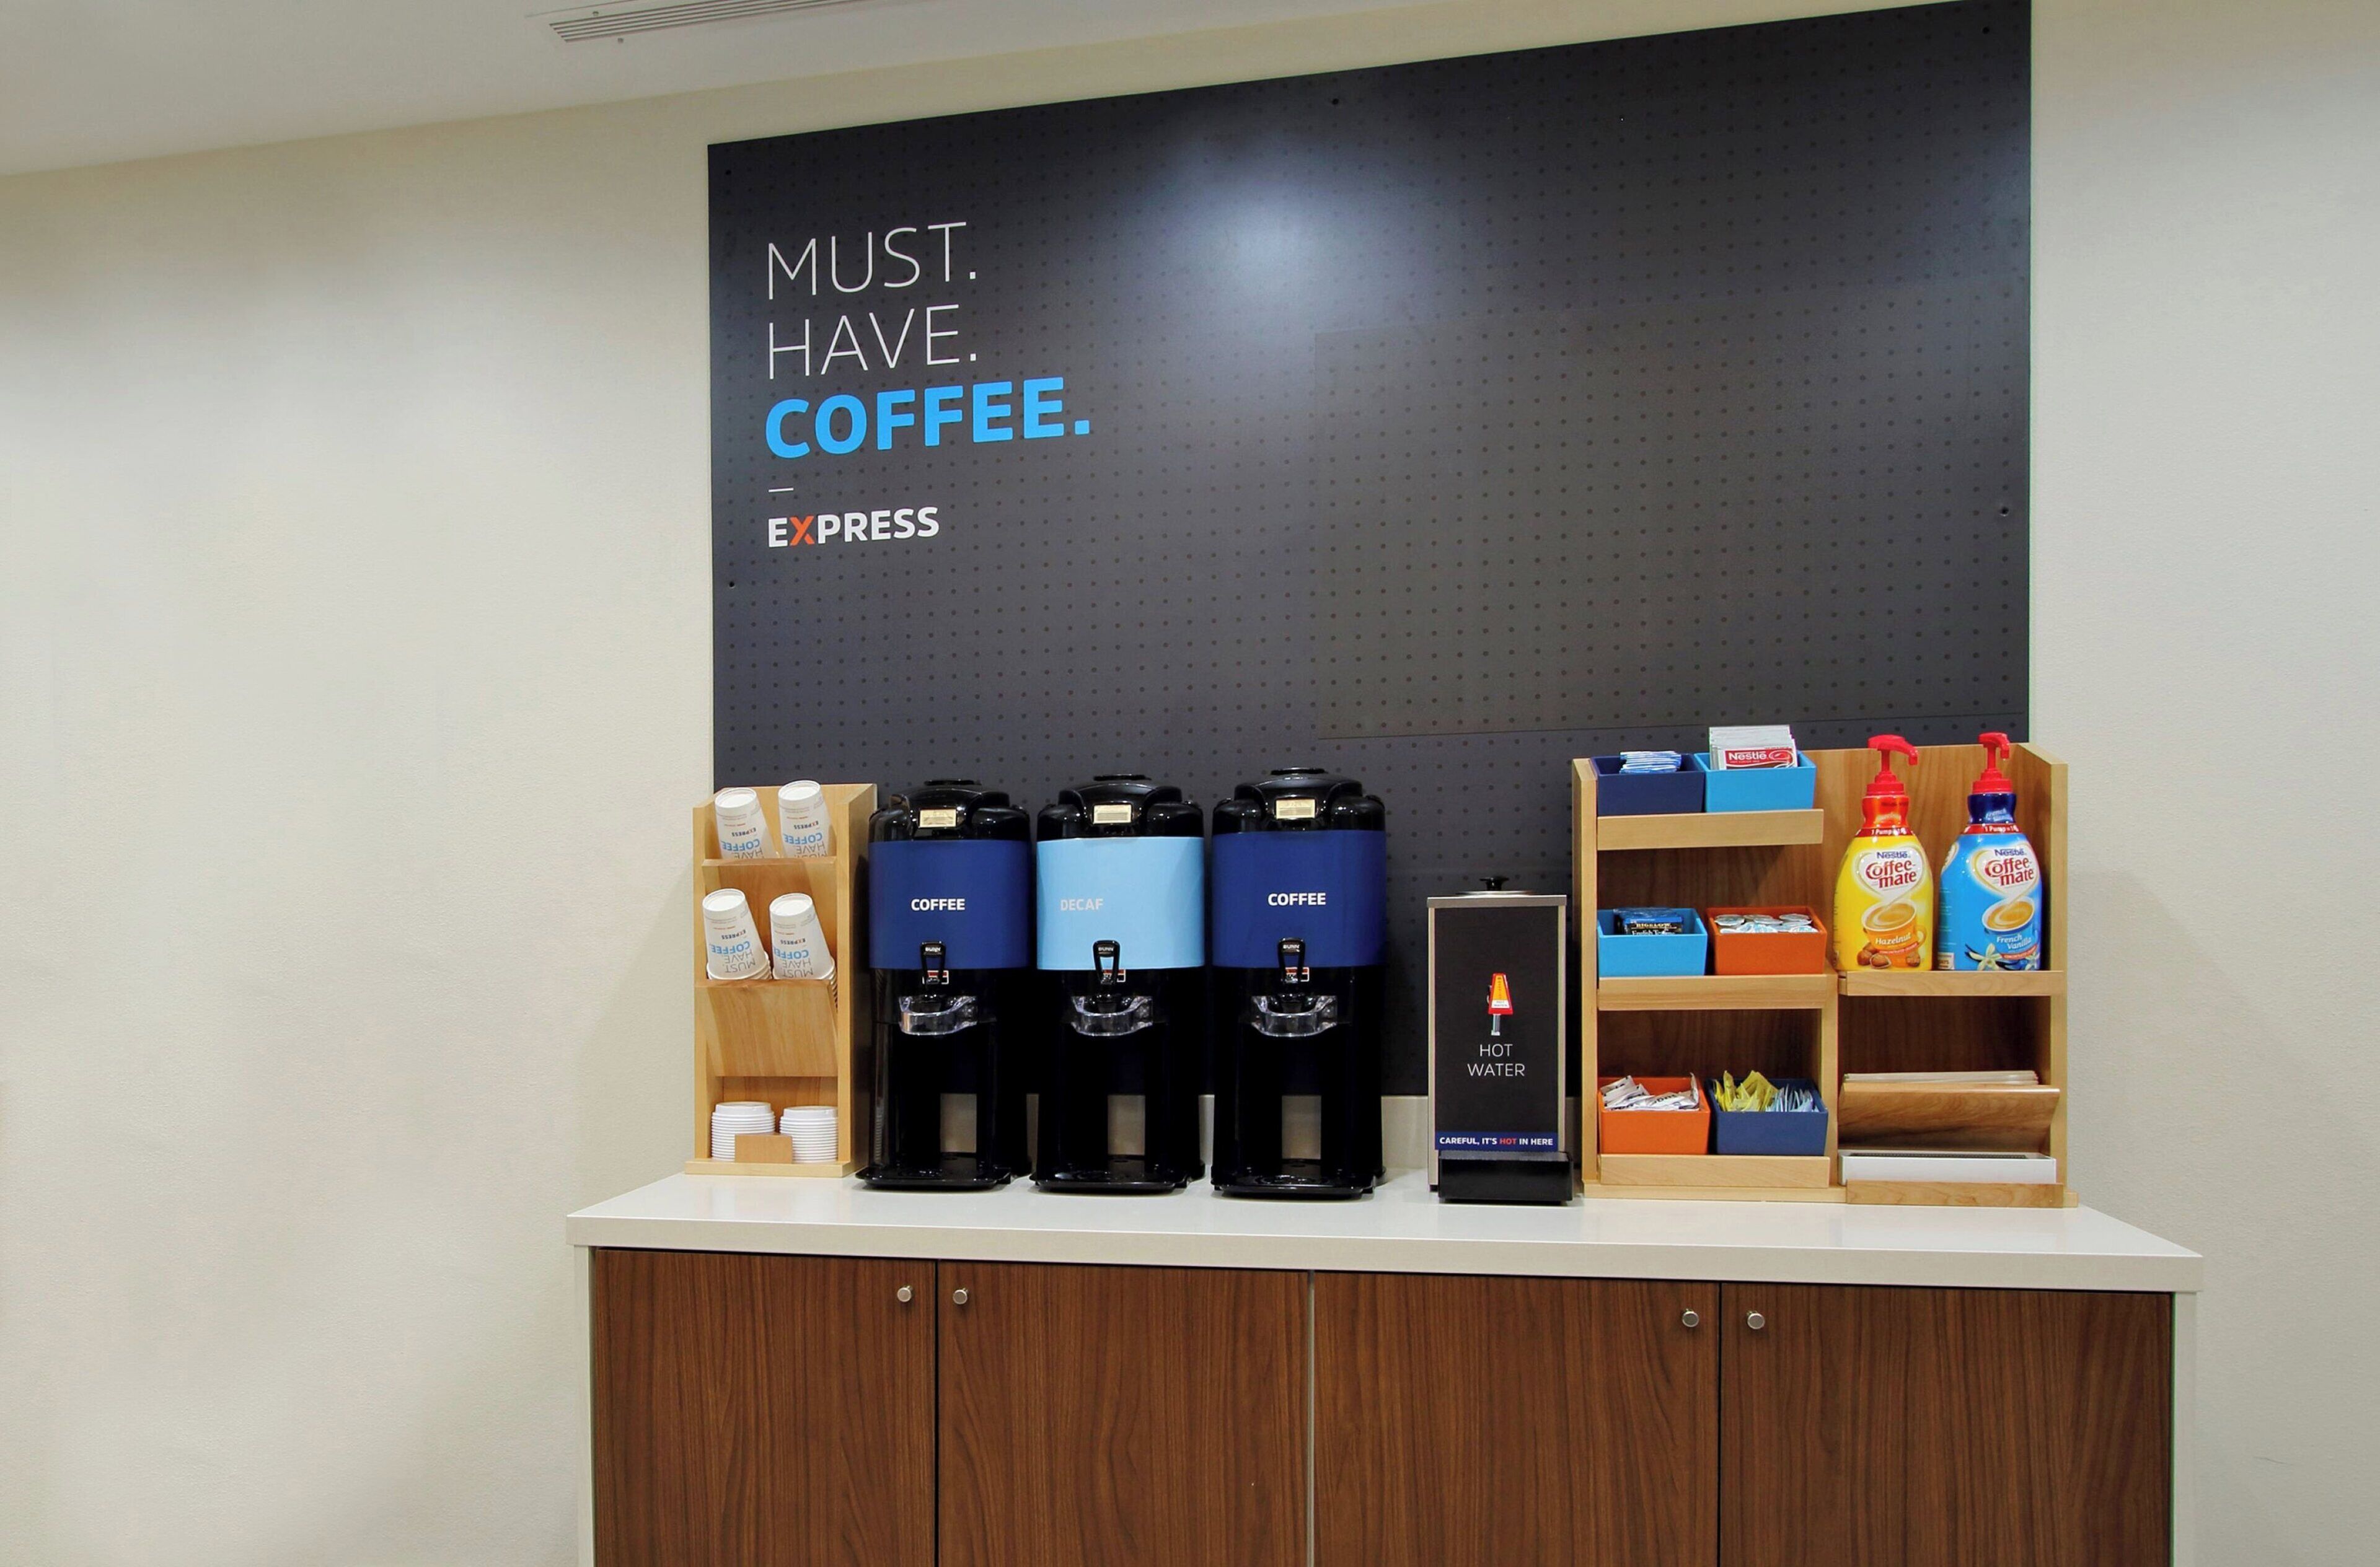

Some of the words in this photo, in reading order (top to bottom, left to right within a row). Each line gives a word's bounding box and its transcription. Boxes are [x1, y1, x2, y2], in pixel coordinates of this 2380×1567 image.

[769, 222, 976, 300] MUST.
[769, 304, 976, 379] HAVE.
[765, 377, 1090, 459] COFFEE.
[769, 507, 939, 547] EXPRESS
[793, 820, 819, 830] EXPRESS
[731, 828, 757, 837] EXPRESS
[1879, 871, 1916, 888] mate
[2000, 869, 2034, 886] mate
[911, 898, 965, 911] COFFEE
[1060, 898, 1103, 911] DECAF
[1267, 892, 1326, 906] COFFEE
[721, 929, 746, 939] EXPRESS
[1875, 932, 1911, 945] Hazelnut
[1997, 933, 2022, 943] French
[780, 937, 806, 946] EXPRESS
[2008, 937, 2031, 949] Vanilla
[1479, 1043, 1513, 1057] HOT
[1467, 1063, 1525, 1076] WATER
[1439, 1137, 1480, 1145] CAREFUL,
